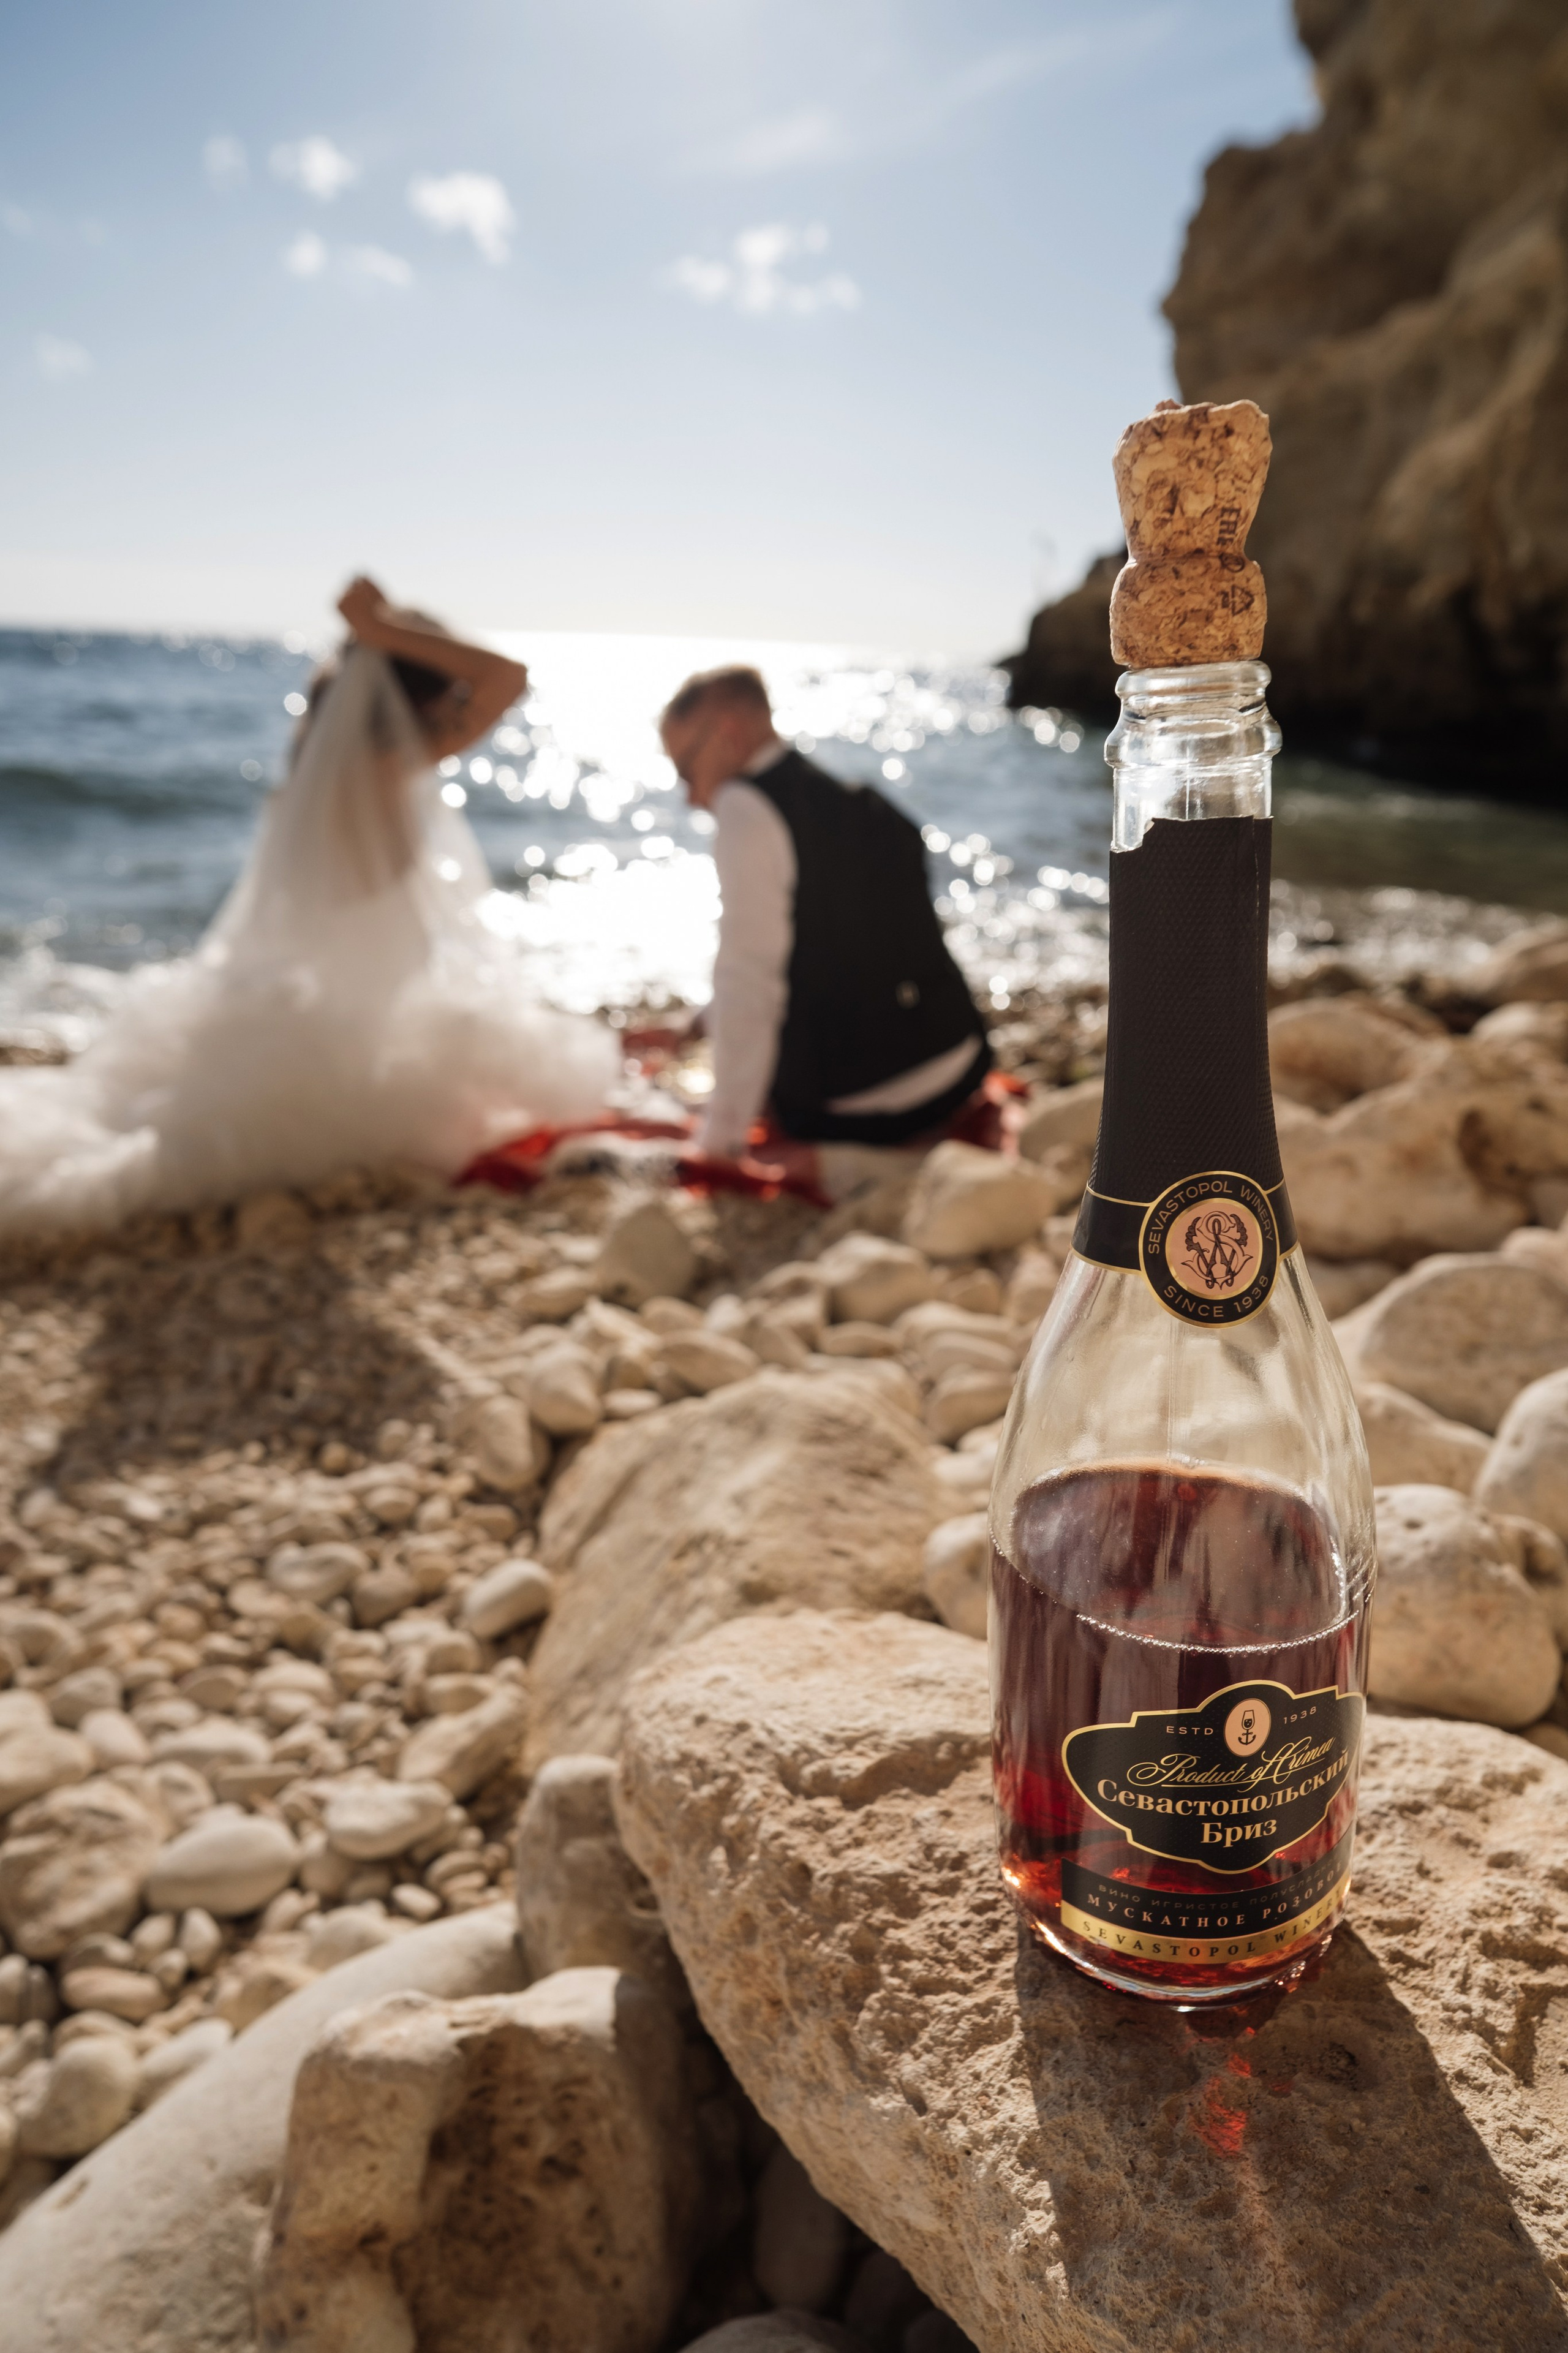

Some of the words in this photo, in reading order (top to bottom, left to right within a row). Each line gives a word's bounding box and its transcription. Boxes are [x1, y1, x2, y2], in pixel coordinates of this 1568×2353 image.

[1148, 1180, 1233, 1255] SEVASTOPOL
[1240, 1185, 1273, 1241] WINERY
[1164, 1285, 1224, 1317] SINCE
[1234, 1275, 1268, 1313] 1938
[1166, 1726, 1213, 1735] ESTD
[1283, 1706, 1317, 1724] 1938
[1126, 1753, 1248, 1786] Product
[1262, 1736, 1336, 1784] Crimea
[1097, 1747, 1348, 1816] Севастопольский
[1200, 1819, 1277, 1848] Бриз
[1087, 1894, 1245, 1927] МУСКАТНОЕ
[1099, 1884, 1140, 1902] ВИНО
[1152, 1899, 1239, 1911] ИГРИСТОЕ
[1083, 1921, 1255, 1957] SEVASTOPOL
